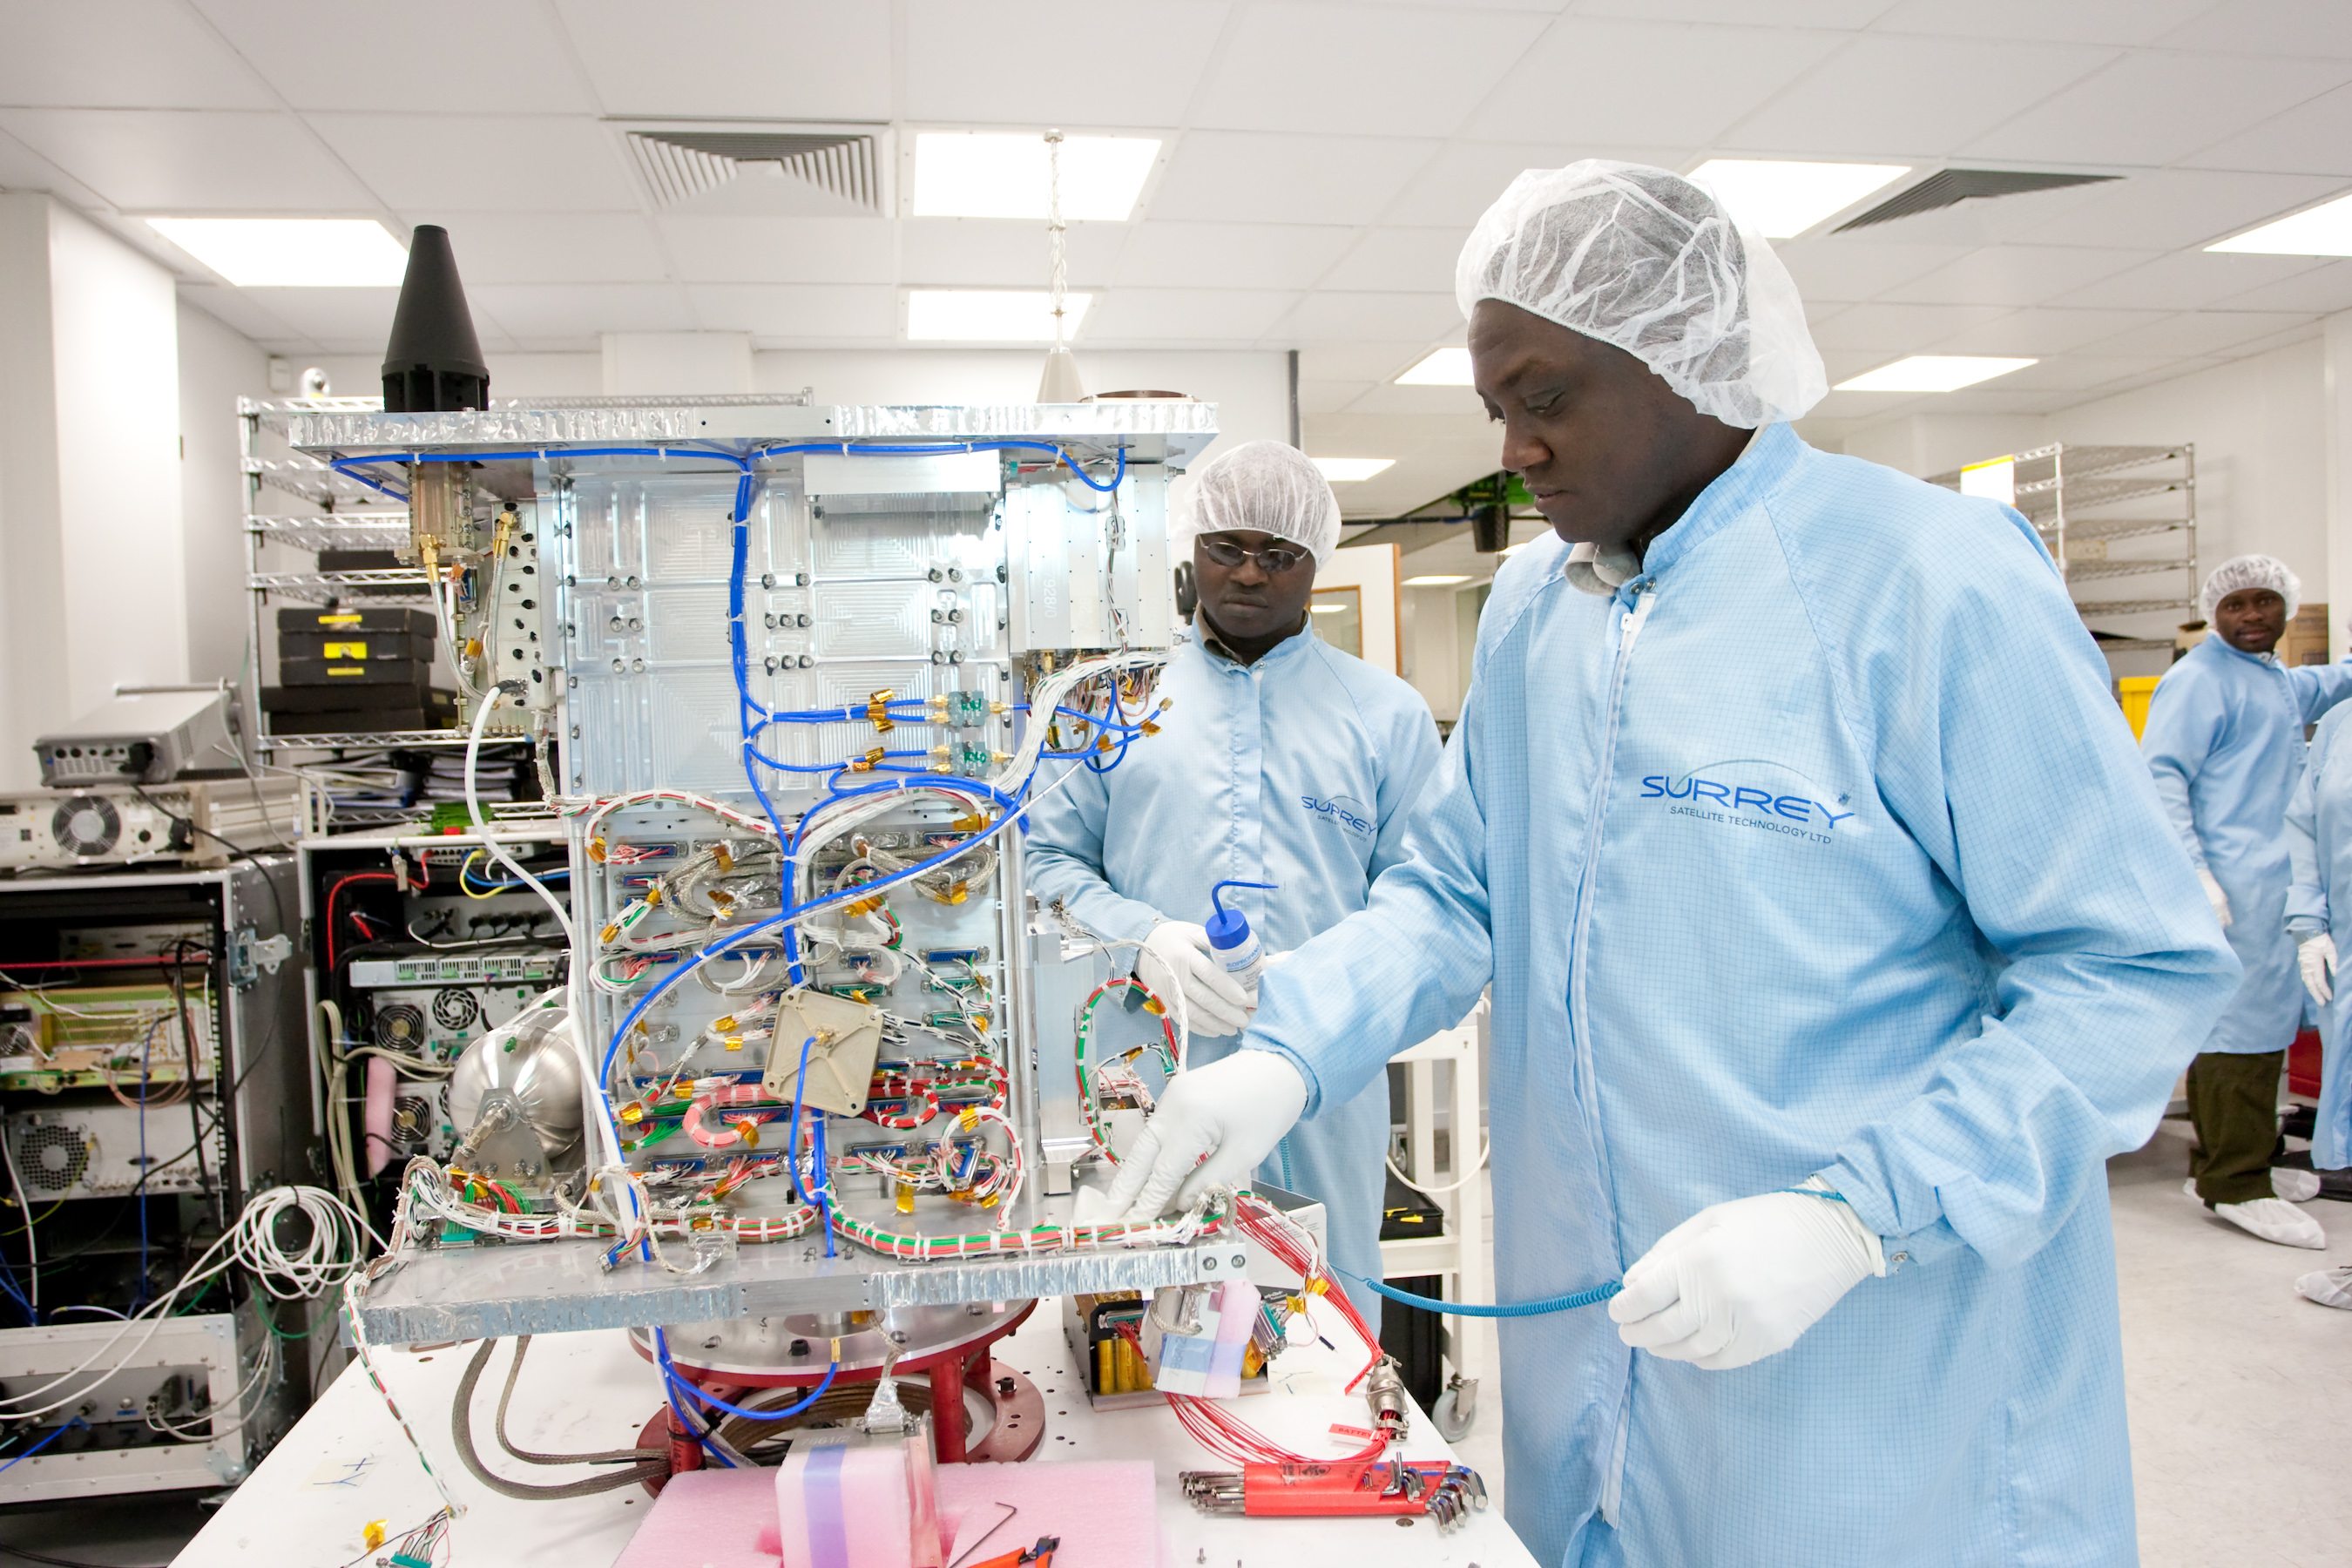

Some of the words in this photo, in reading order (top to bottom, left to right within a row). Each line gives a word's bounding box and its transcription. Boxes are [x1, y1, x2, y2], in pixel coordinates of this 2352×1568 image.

[1301, 796, 1376, 835] SURREY
[1640, 775, 1855, 829] SURREY
[1670, 806, 1725, 822] SATELLITE
[1728, 816, 1808, 838] TECHNOLOGY
[1810, 832, 1832, 844] LTD
